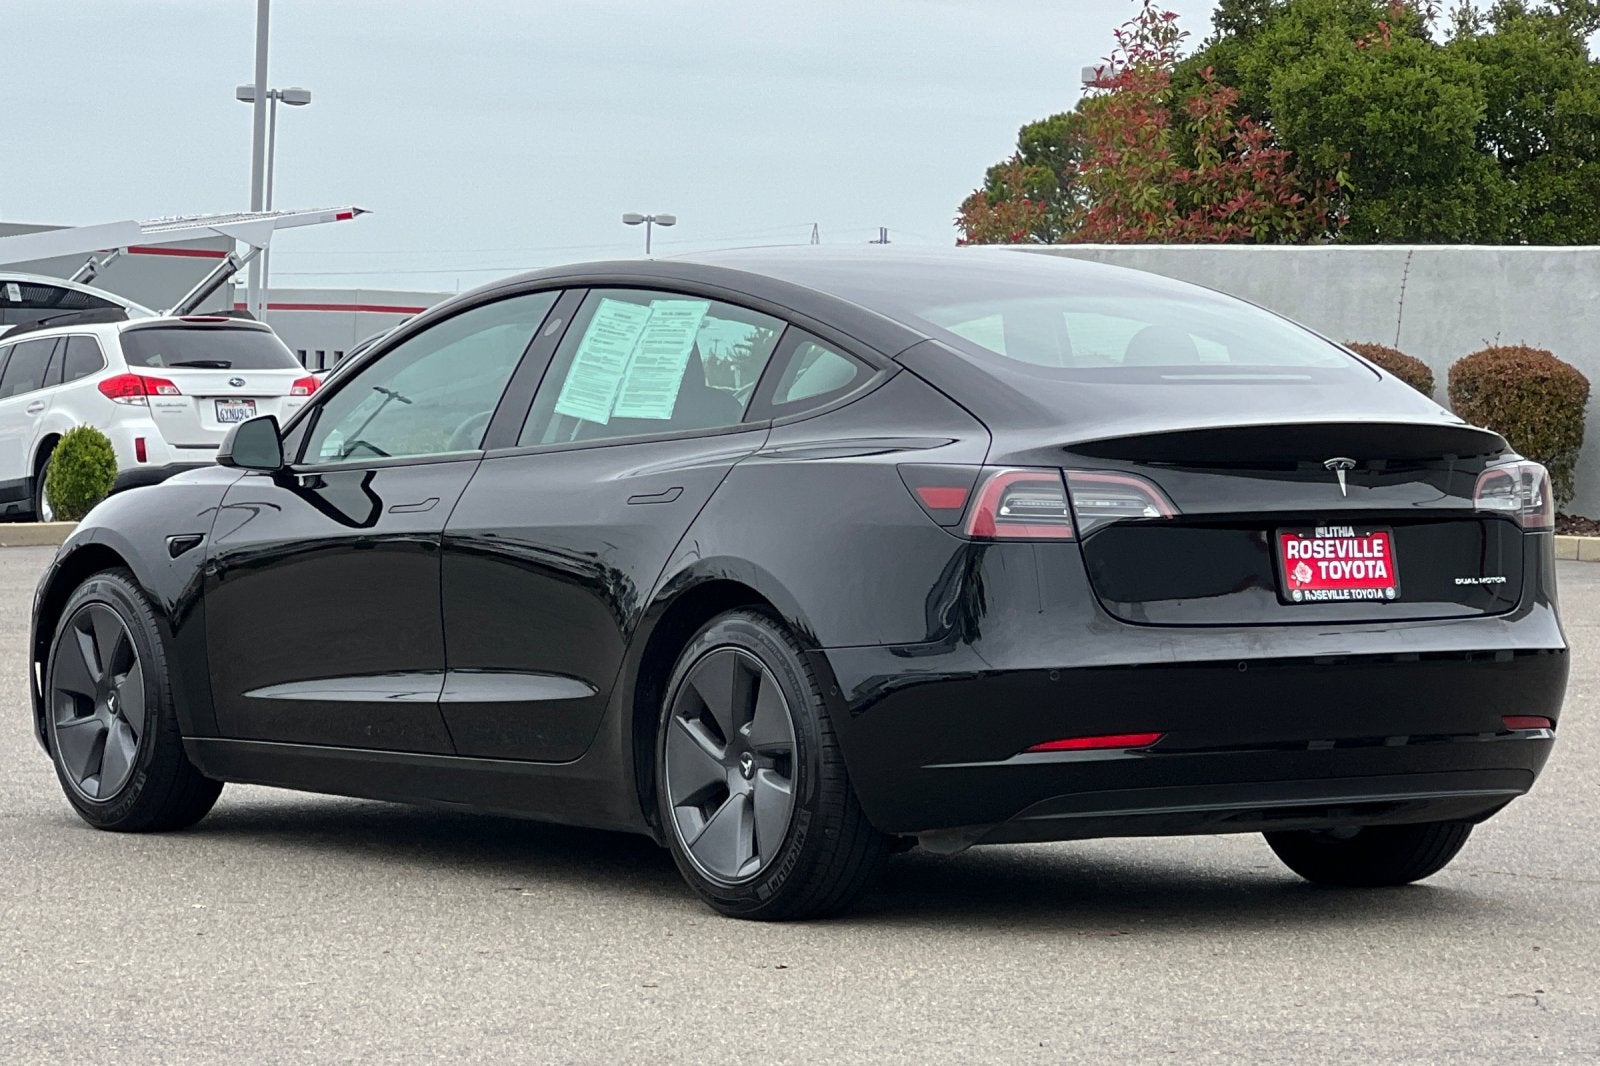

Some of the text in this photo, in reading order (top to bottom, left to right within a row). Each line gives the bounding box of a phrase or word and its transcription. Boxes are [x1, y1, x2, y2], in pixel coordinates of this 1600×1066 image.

[1324, 526, 1355, 538] LITHIA
[1287, 539, 1384, 559] ROSEVILLE
[1317, 560, 1388, 580] TOYOTA
[1455, 576, 1507, 585] DUAL MOTOR
[1304, 588, 1384, 600] ROSEVILLE TOYOTA
[771, 829, 805, 892] MICHELIN
